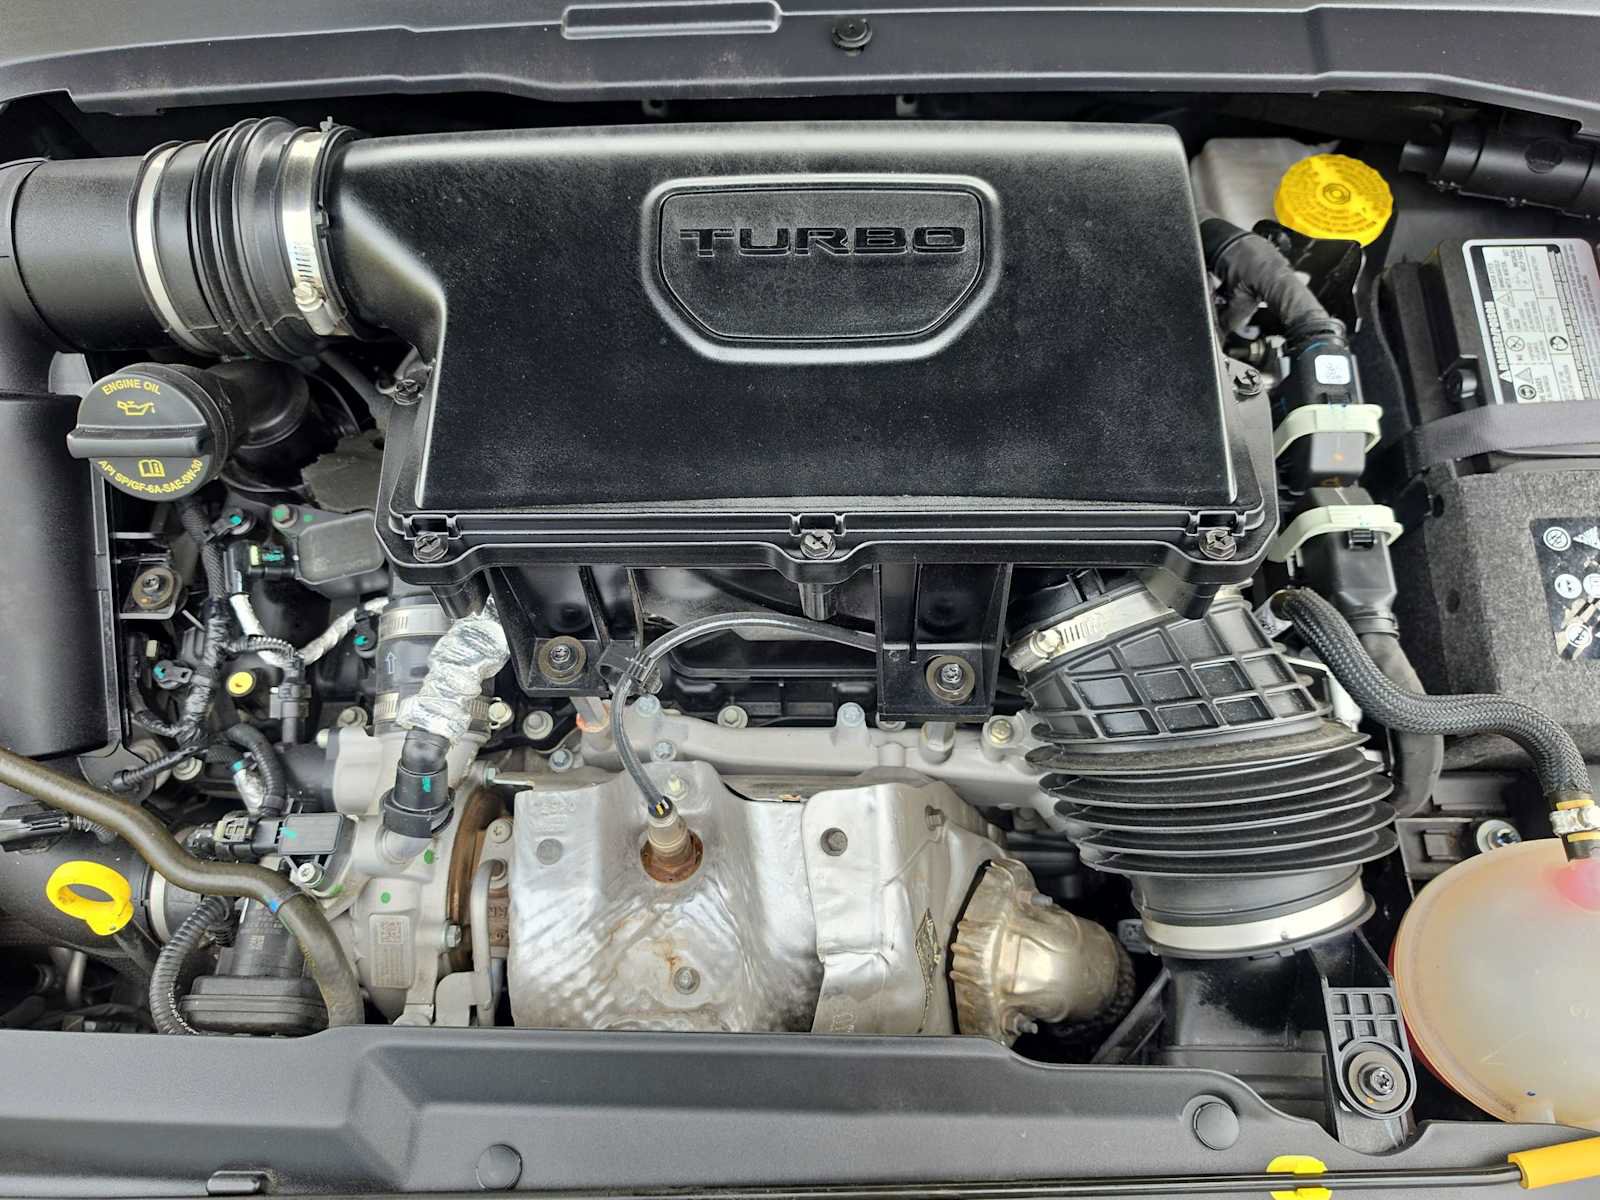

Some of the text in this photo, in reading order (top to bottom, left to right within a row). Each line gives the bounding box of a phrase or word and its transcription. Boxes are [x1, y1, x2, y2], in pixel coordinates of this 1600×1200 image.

[680, 227, 966, 257] TURBO
[101, 378, 161, 396] ENGINE OIL
[97, 460, 115, 476] API
